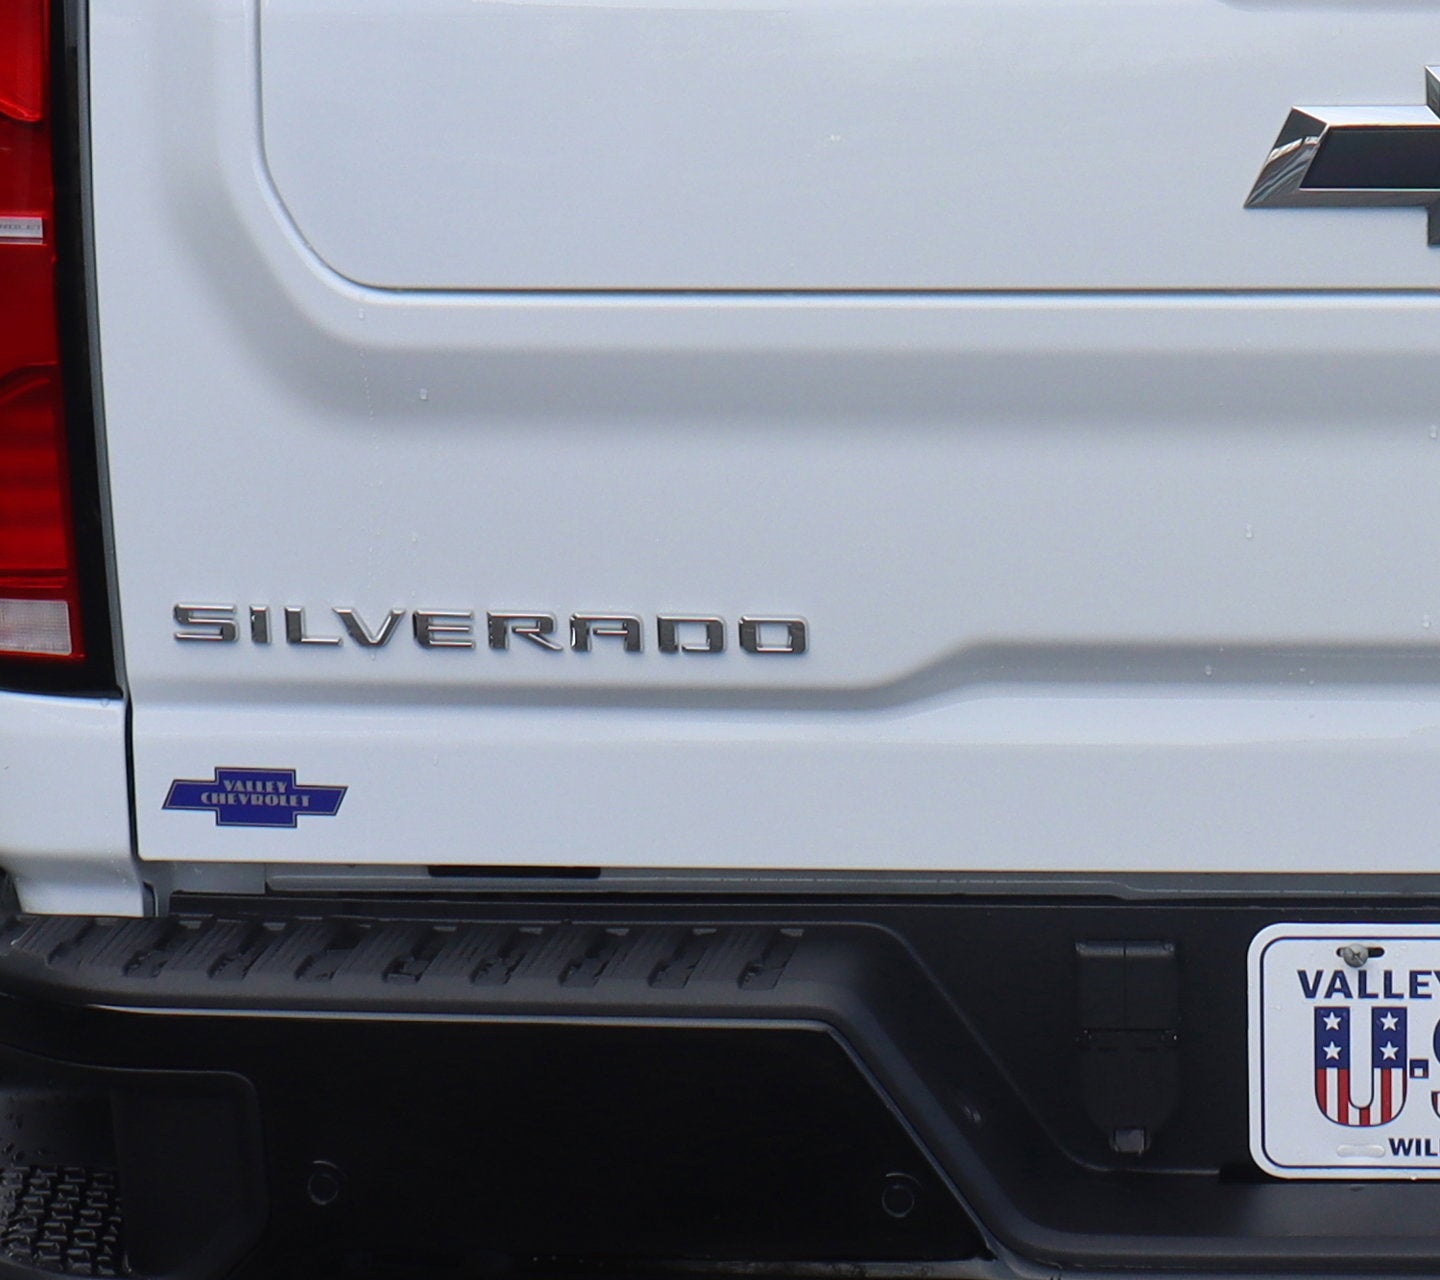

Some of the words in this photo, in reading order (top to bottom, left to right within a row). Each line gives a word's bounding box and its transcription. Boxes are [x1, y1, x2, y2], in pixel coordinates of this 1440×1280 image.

[172, 602, 809, 655] SILVERADO
[223, 780, 288, 793] VALLEY
[200, 792, 311, 807] CHEVROLET
